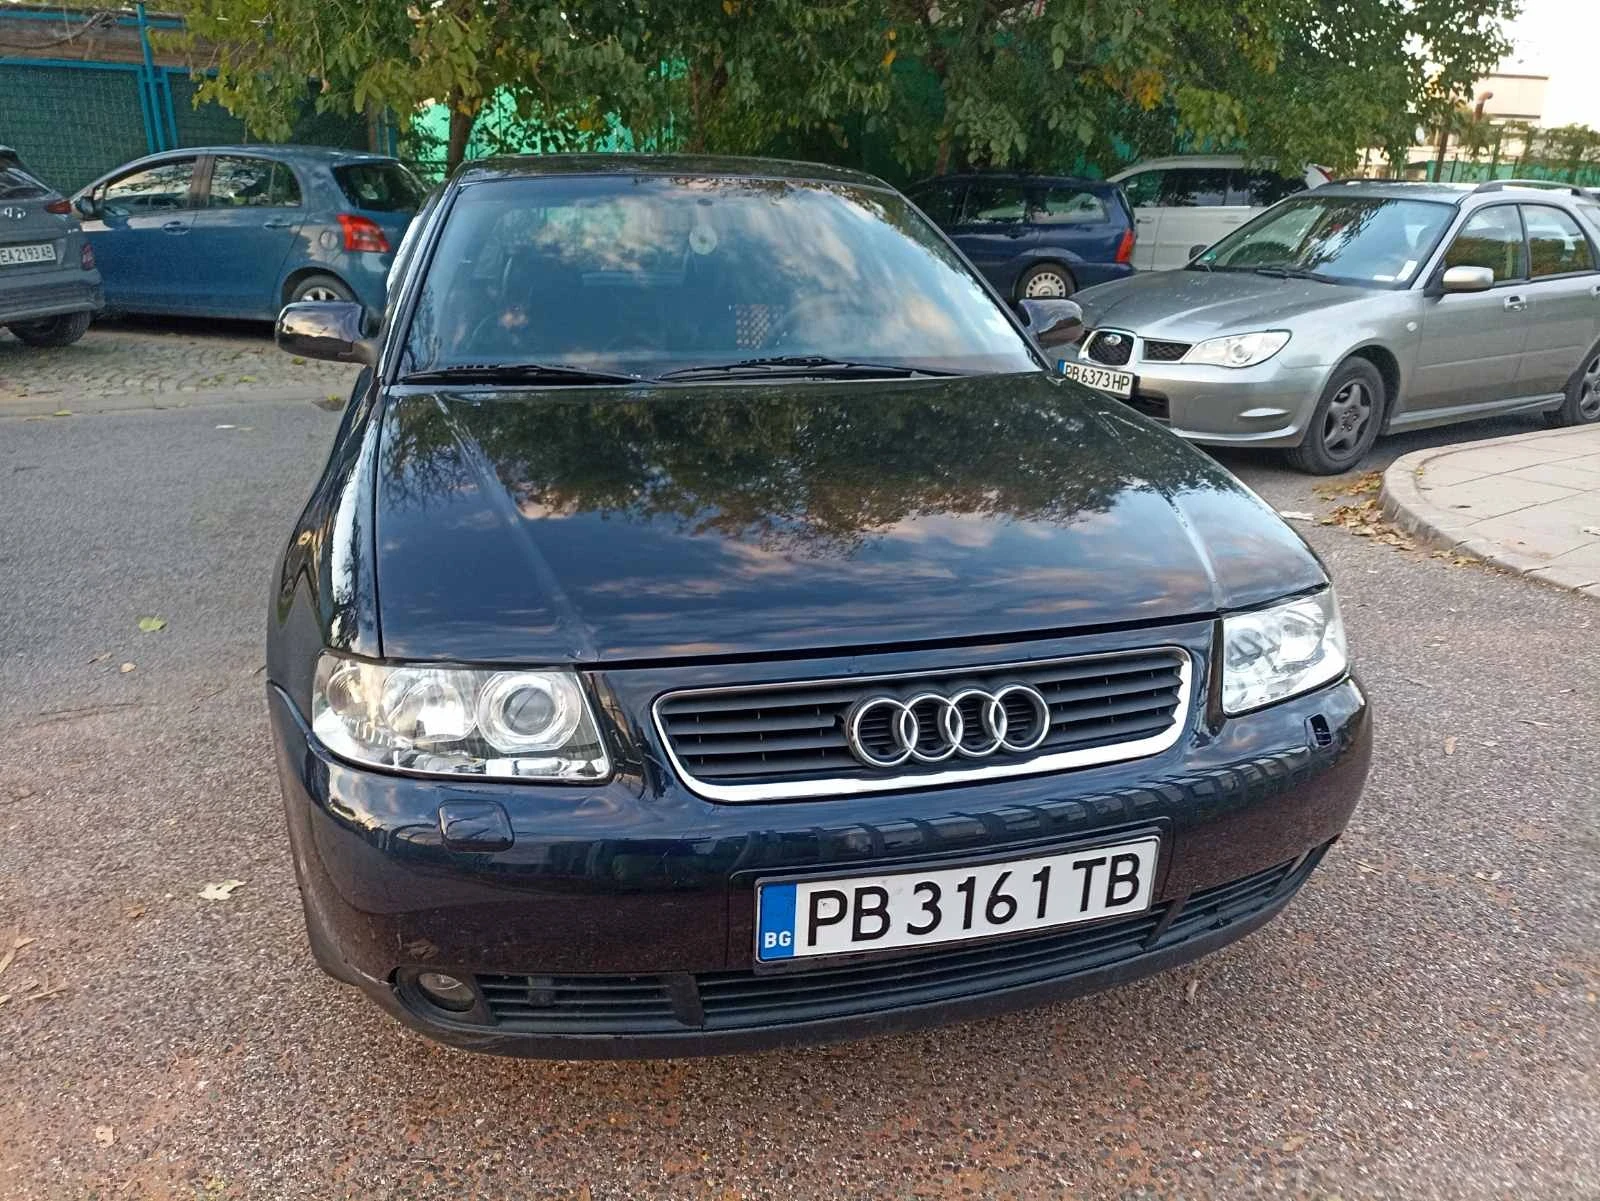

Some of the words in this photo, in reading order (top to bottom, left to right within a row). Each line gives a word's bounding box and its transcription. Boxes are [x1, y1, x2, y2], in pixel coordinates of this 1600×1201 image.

[1065, 364, 1079, 381] PB
[1081, 368, 1110, 388] 6373
[1112, 373, 1130, 391] HP
[807, 885, 891, 947] PB
[906, 865, 1052, 936] 3161
[1072, 852, 1141, 912] TB
[764, 930, 792, 949] BG
